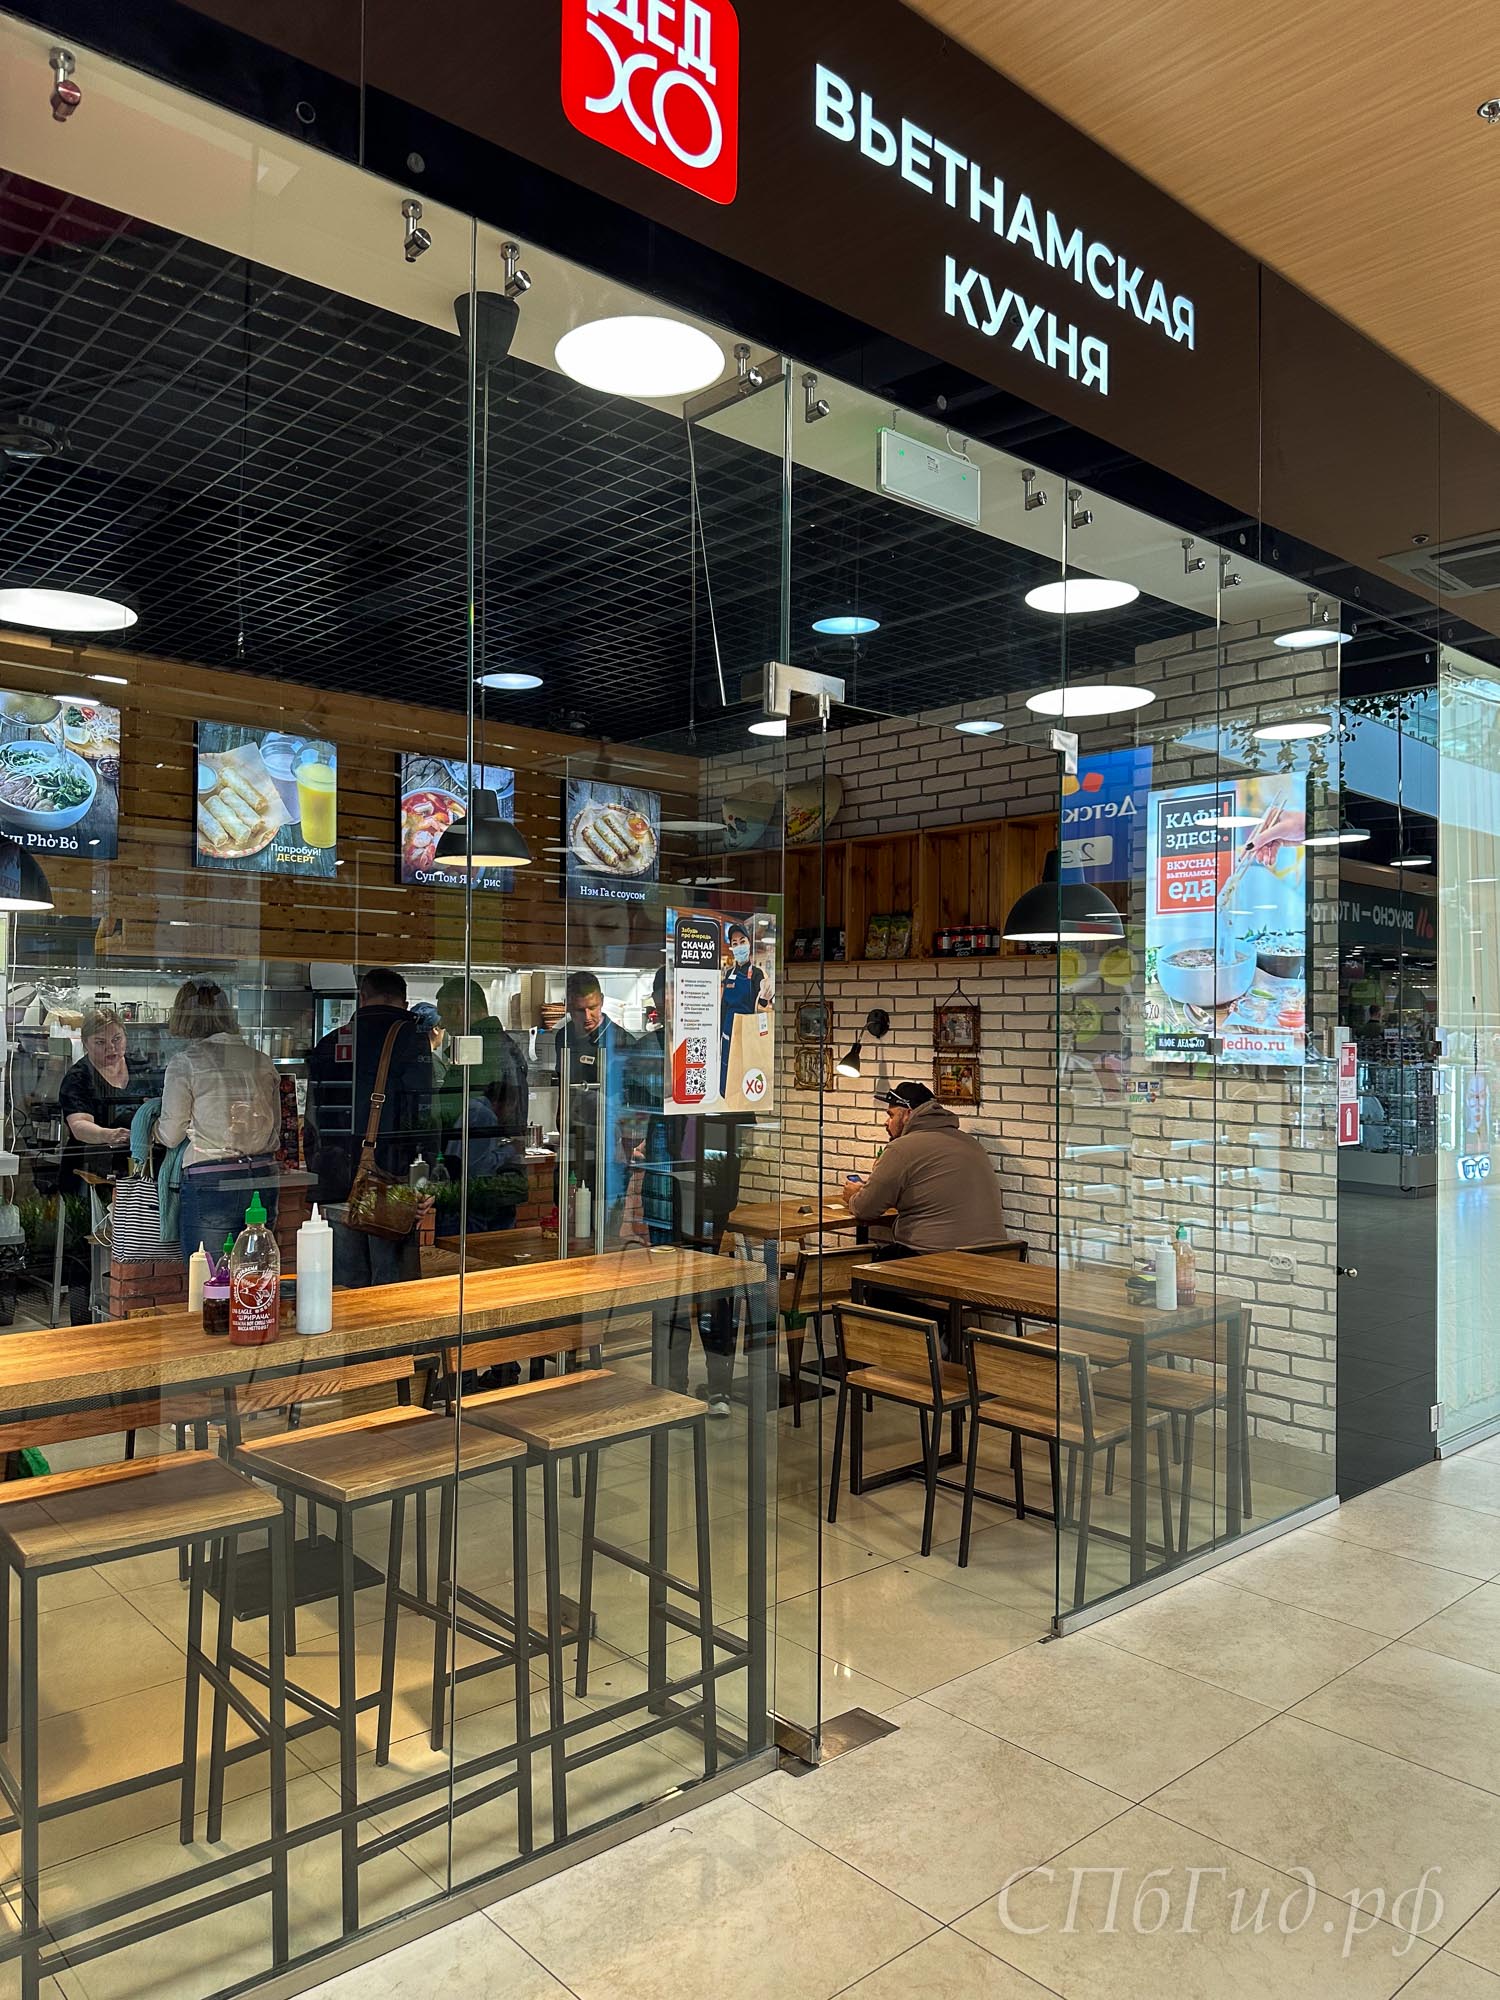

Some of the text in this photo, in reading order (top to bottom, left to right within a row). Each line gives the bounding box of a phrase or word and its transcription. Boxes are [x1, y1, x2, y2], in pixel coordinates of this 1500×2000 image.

[585, 18, 723, 169] ХО
[814, 62, 1196, 351] ВЬЕТНАМСКАЯ
[943, 254, 1110, 396] КУХНЯ
[270, 842, 322, 857] Попробуй!
[276, 853, 315, 864] ДЕСЕРТ
[415, 870, 435, 883] Суп
[483, 878, 501, 888] рис
[580, 885, 599, 896] Нэм
[600, 887, 610, 897] Га
[616, 890, 646, 901] соусом
[1168, 878, 1217, 902] еда
[681, 940, 715, 951] СКАЧАЙ
[681, 949, 713, 960] ДЕД ХО
